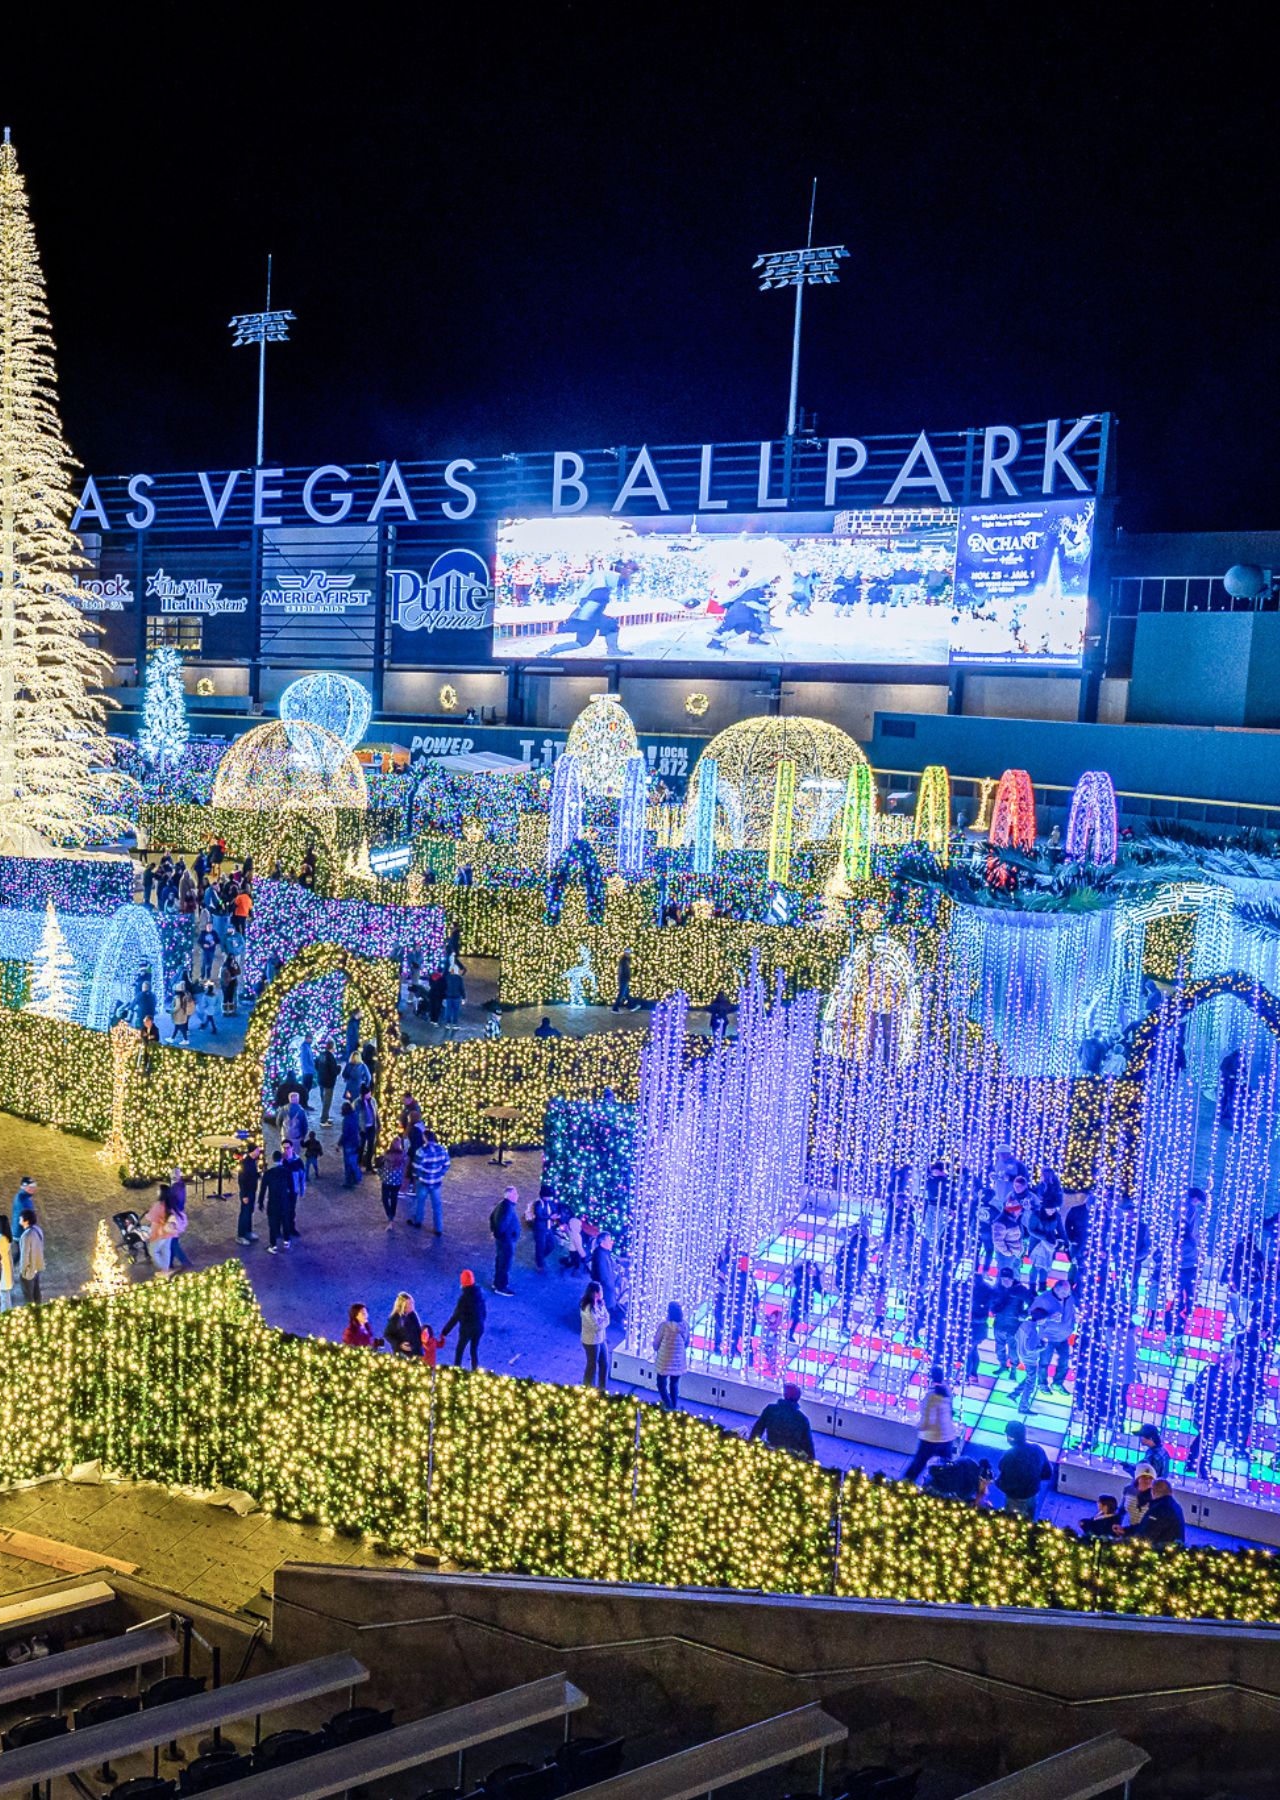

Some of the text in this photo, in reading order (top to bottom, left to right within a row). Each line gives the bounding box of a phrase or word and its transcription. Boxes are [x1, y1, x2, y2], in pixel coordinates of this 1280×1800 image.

[70, 414, 1093, 530] AS VEGAS BALLPARK
[183, 579, 222, 600] Valley
[261, 591, 370, 605] AMERICA FIRST
[387, 570, 489, 623] Pulte
[161, 598, 206, 612] Health
[404, 606, 490, 633] Homes
[411, 736, 474, 756] POWER
[660, 746, 688, 758] LOCAL
[660, 758, 688, 776] 872
